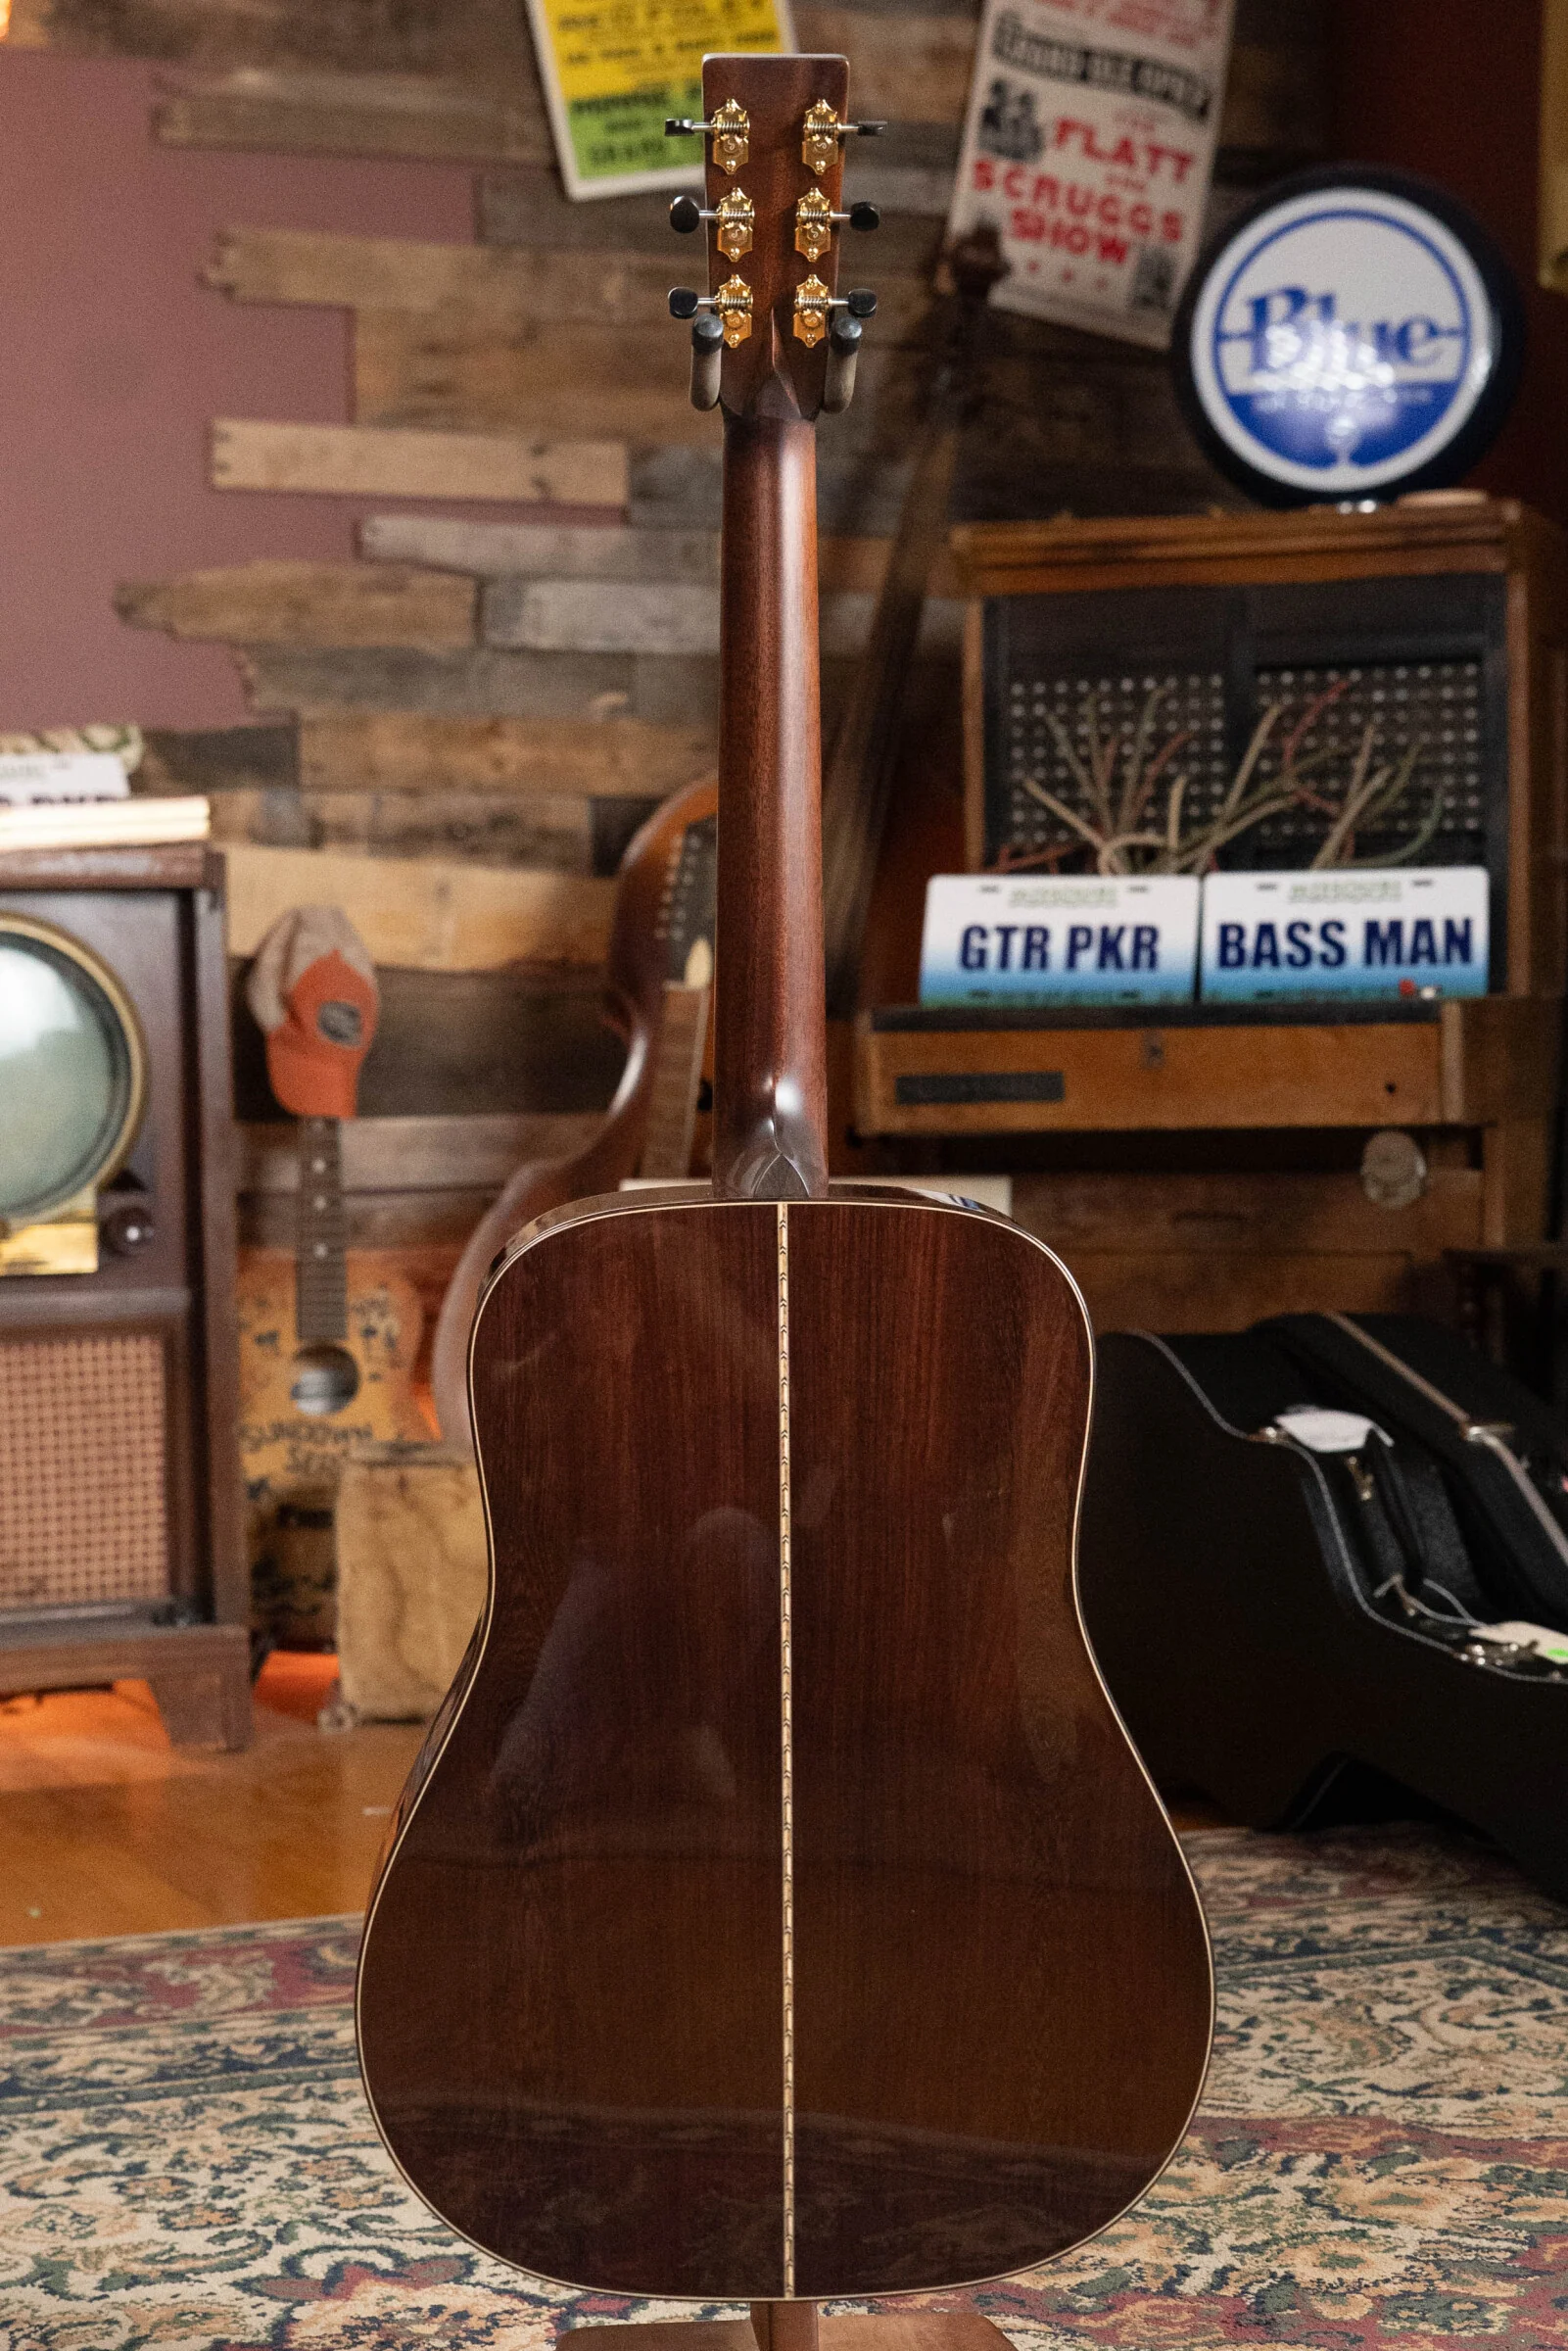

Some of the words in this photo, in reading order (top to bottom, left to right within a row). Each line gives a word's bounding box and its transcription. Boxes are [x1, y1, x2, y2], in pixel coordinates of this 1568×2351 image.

[1054, 116, 1196, 184] FLATT
[972, 157, 1182, 244] SCRUGGS
[1010, 207, 1129, 265] SHOW
[1247, 285, 1443, 376] Blue
[959, 923, 1050, 972] GTR
[1065, 923, 1160, 972] PKR
[1217, 919, 1348, 969] BASS
[1362, 915, 1473, 967] MAN
